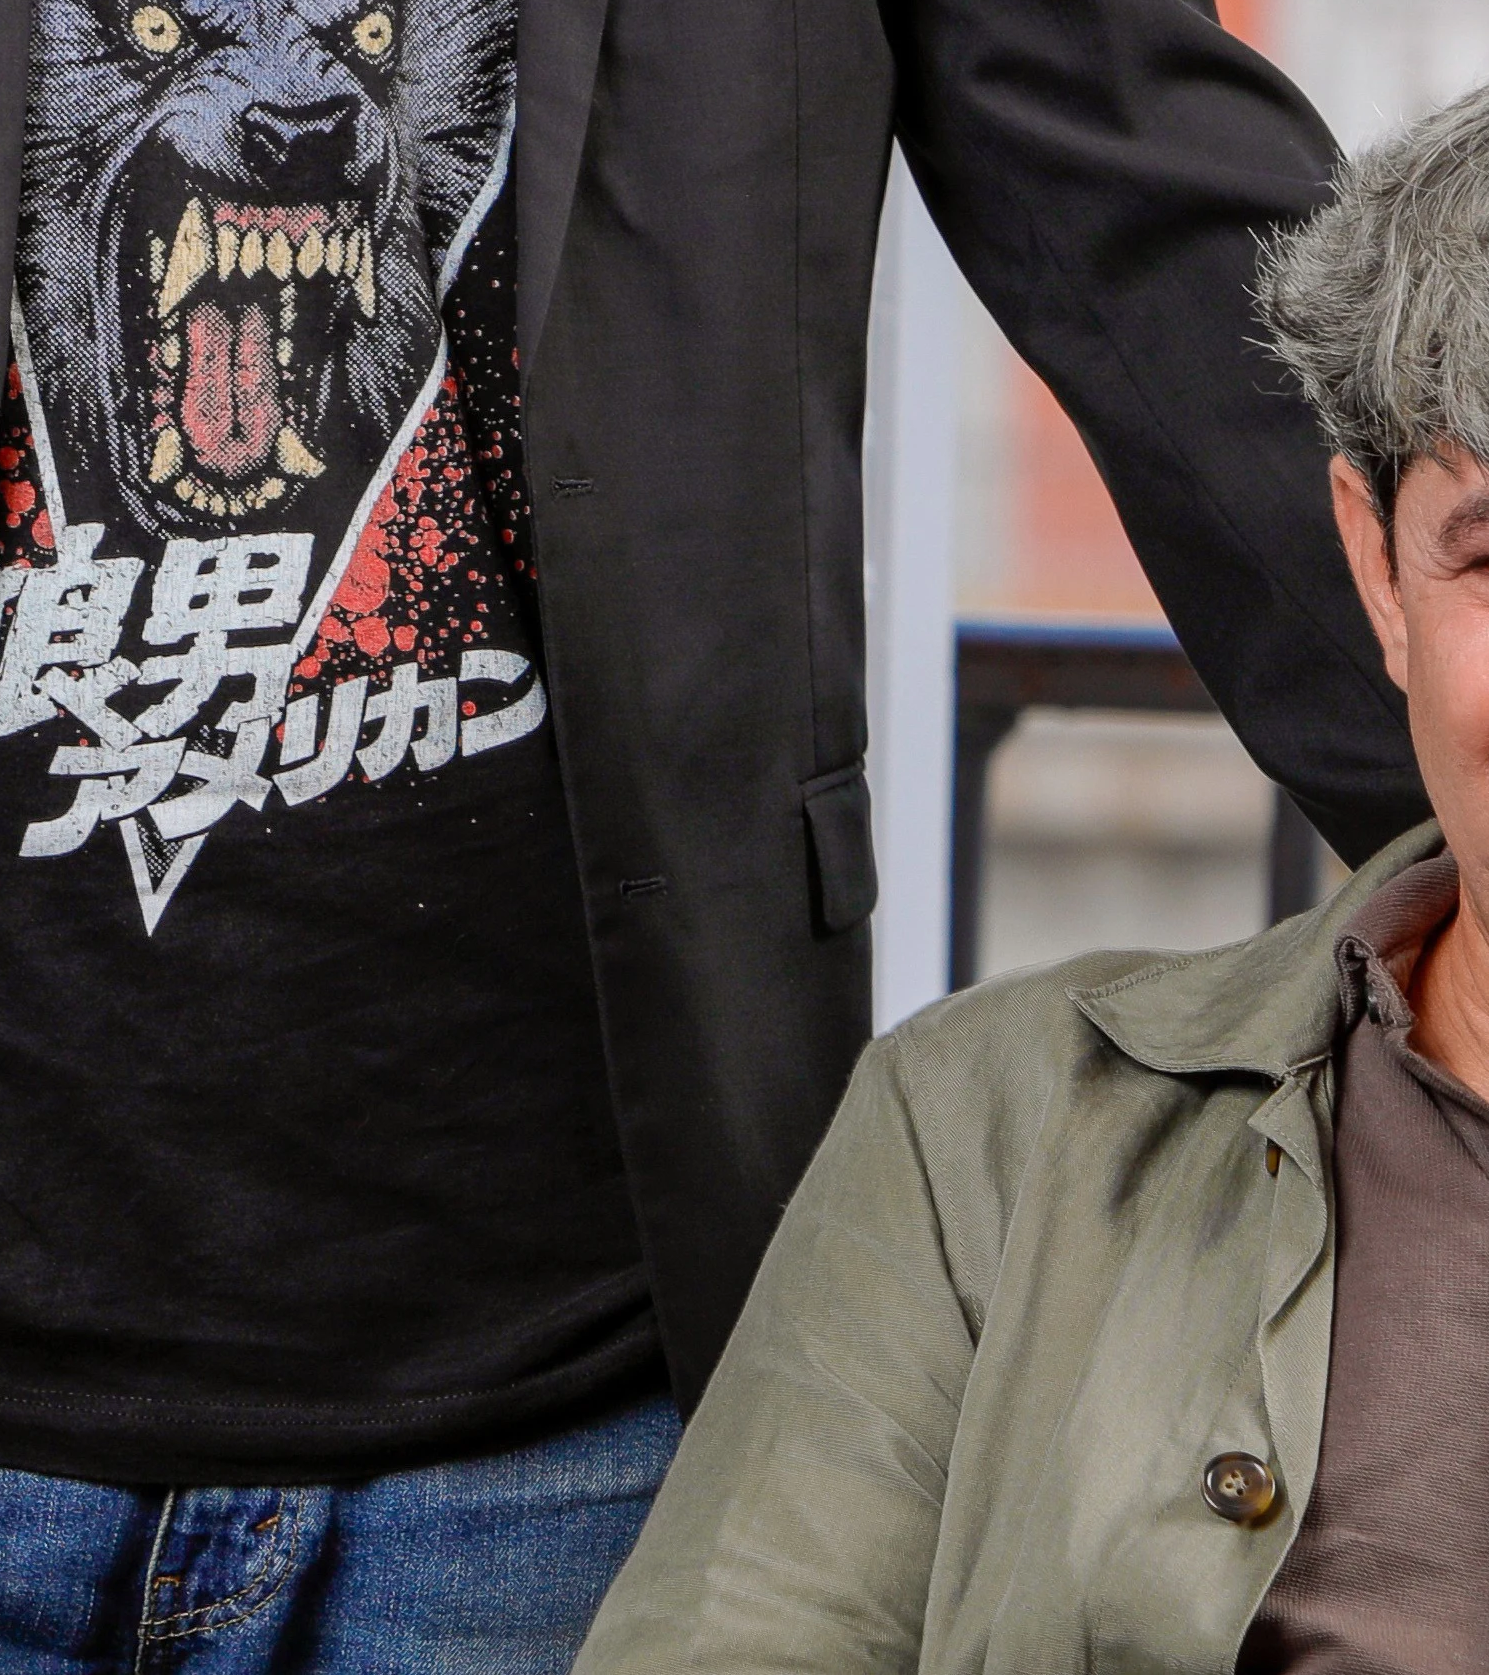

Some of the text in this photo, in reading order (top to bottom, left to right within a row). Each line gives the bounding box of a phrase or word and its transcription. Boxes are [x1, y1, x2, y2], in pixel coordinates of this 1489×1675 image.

[18, 648, 548, 857] アメリカン
